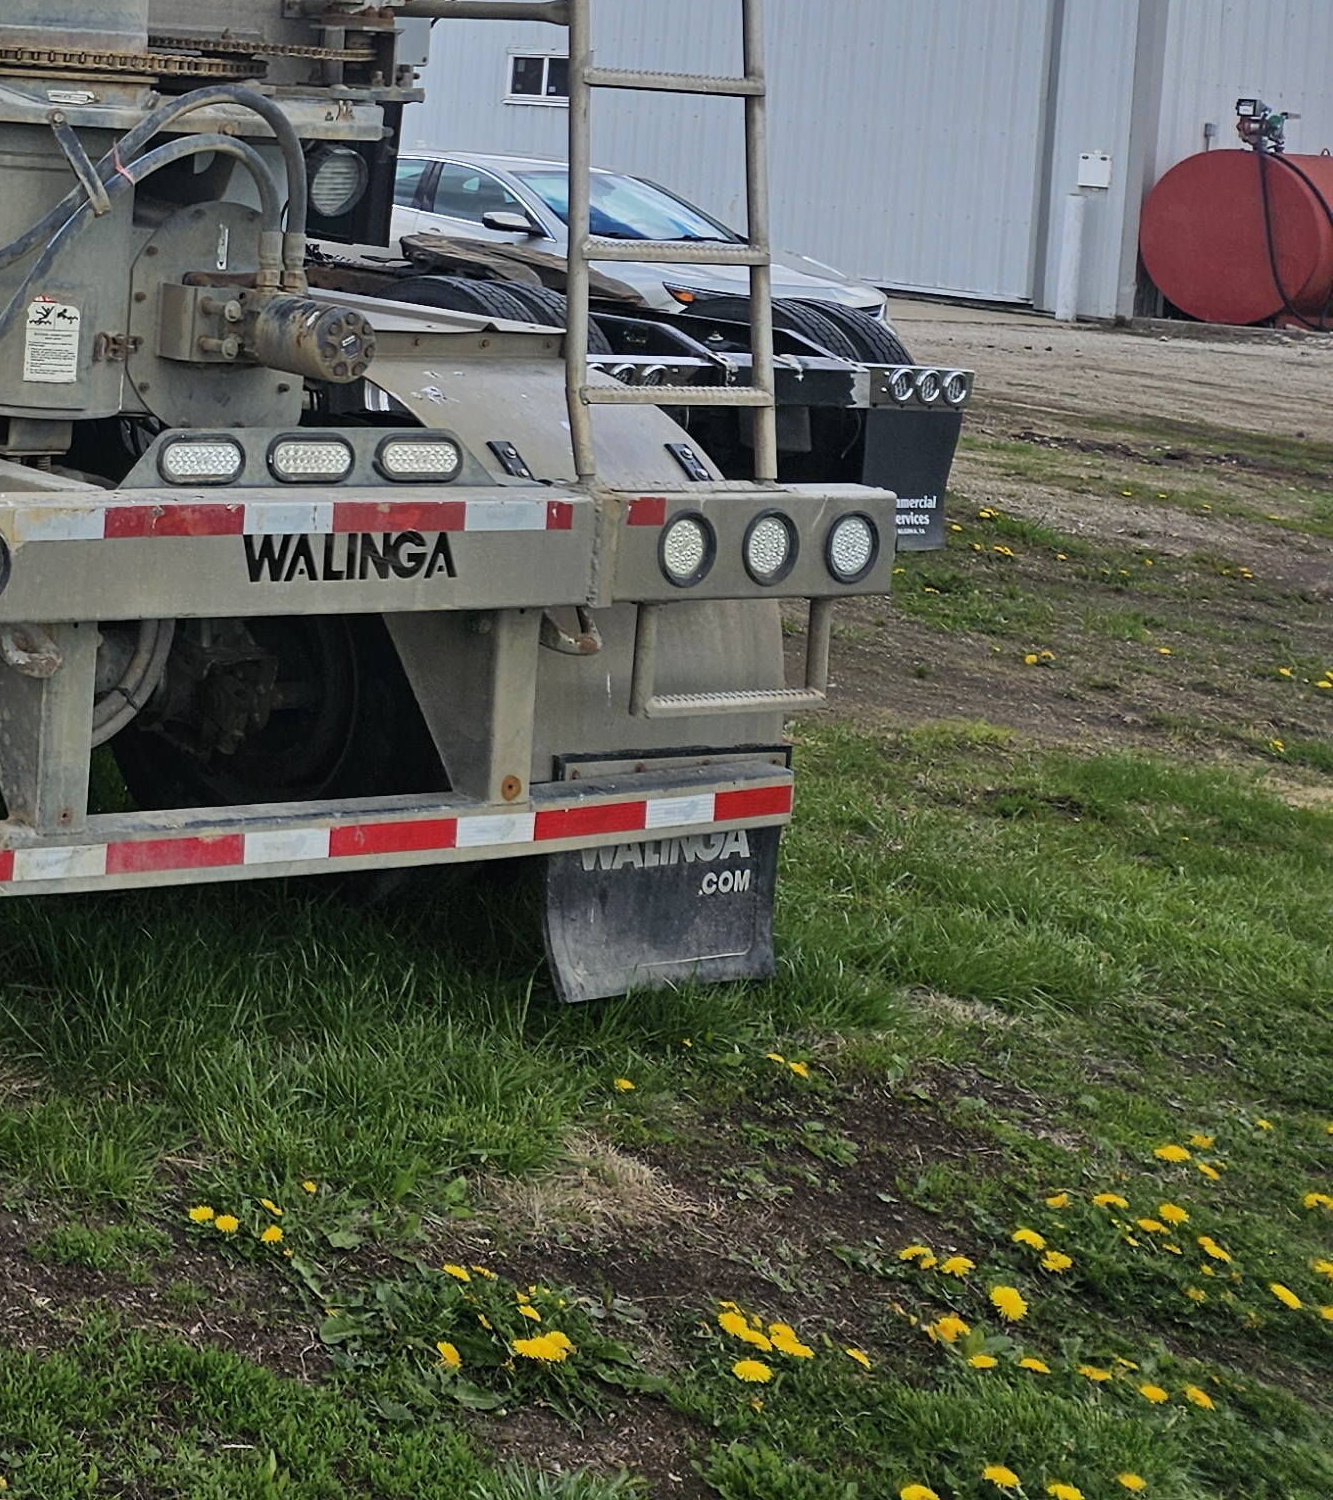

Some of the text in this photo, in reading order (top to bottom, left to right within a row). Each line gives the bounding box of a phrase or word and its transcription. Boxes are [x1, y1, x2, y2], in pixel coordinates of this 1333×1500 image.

[895, 512, 930, 525] ervices
[243, 531, 458, 582] WALINGA
[580, 830, 751, 871] WALINGA
[698, 869, 751, 896] .COM
